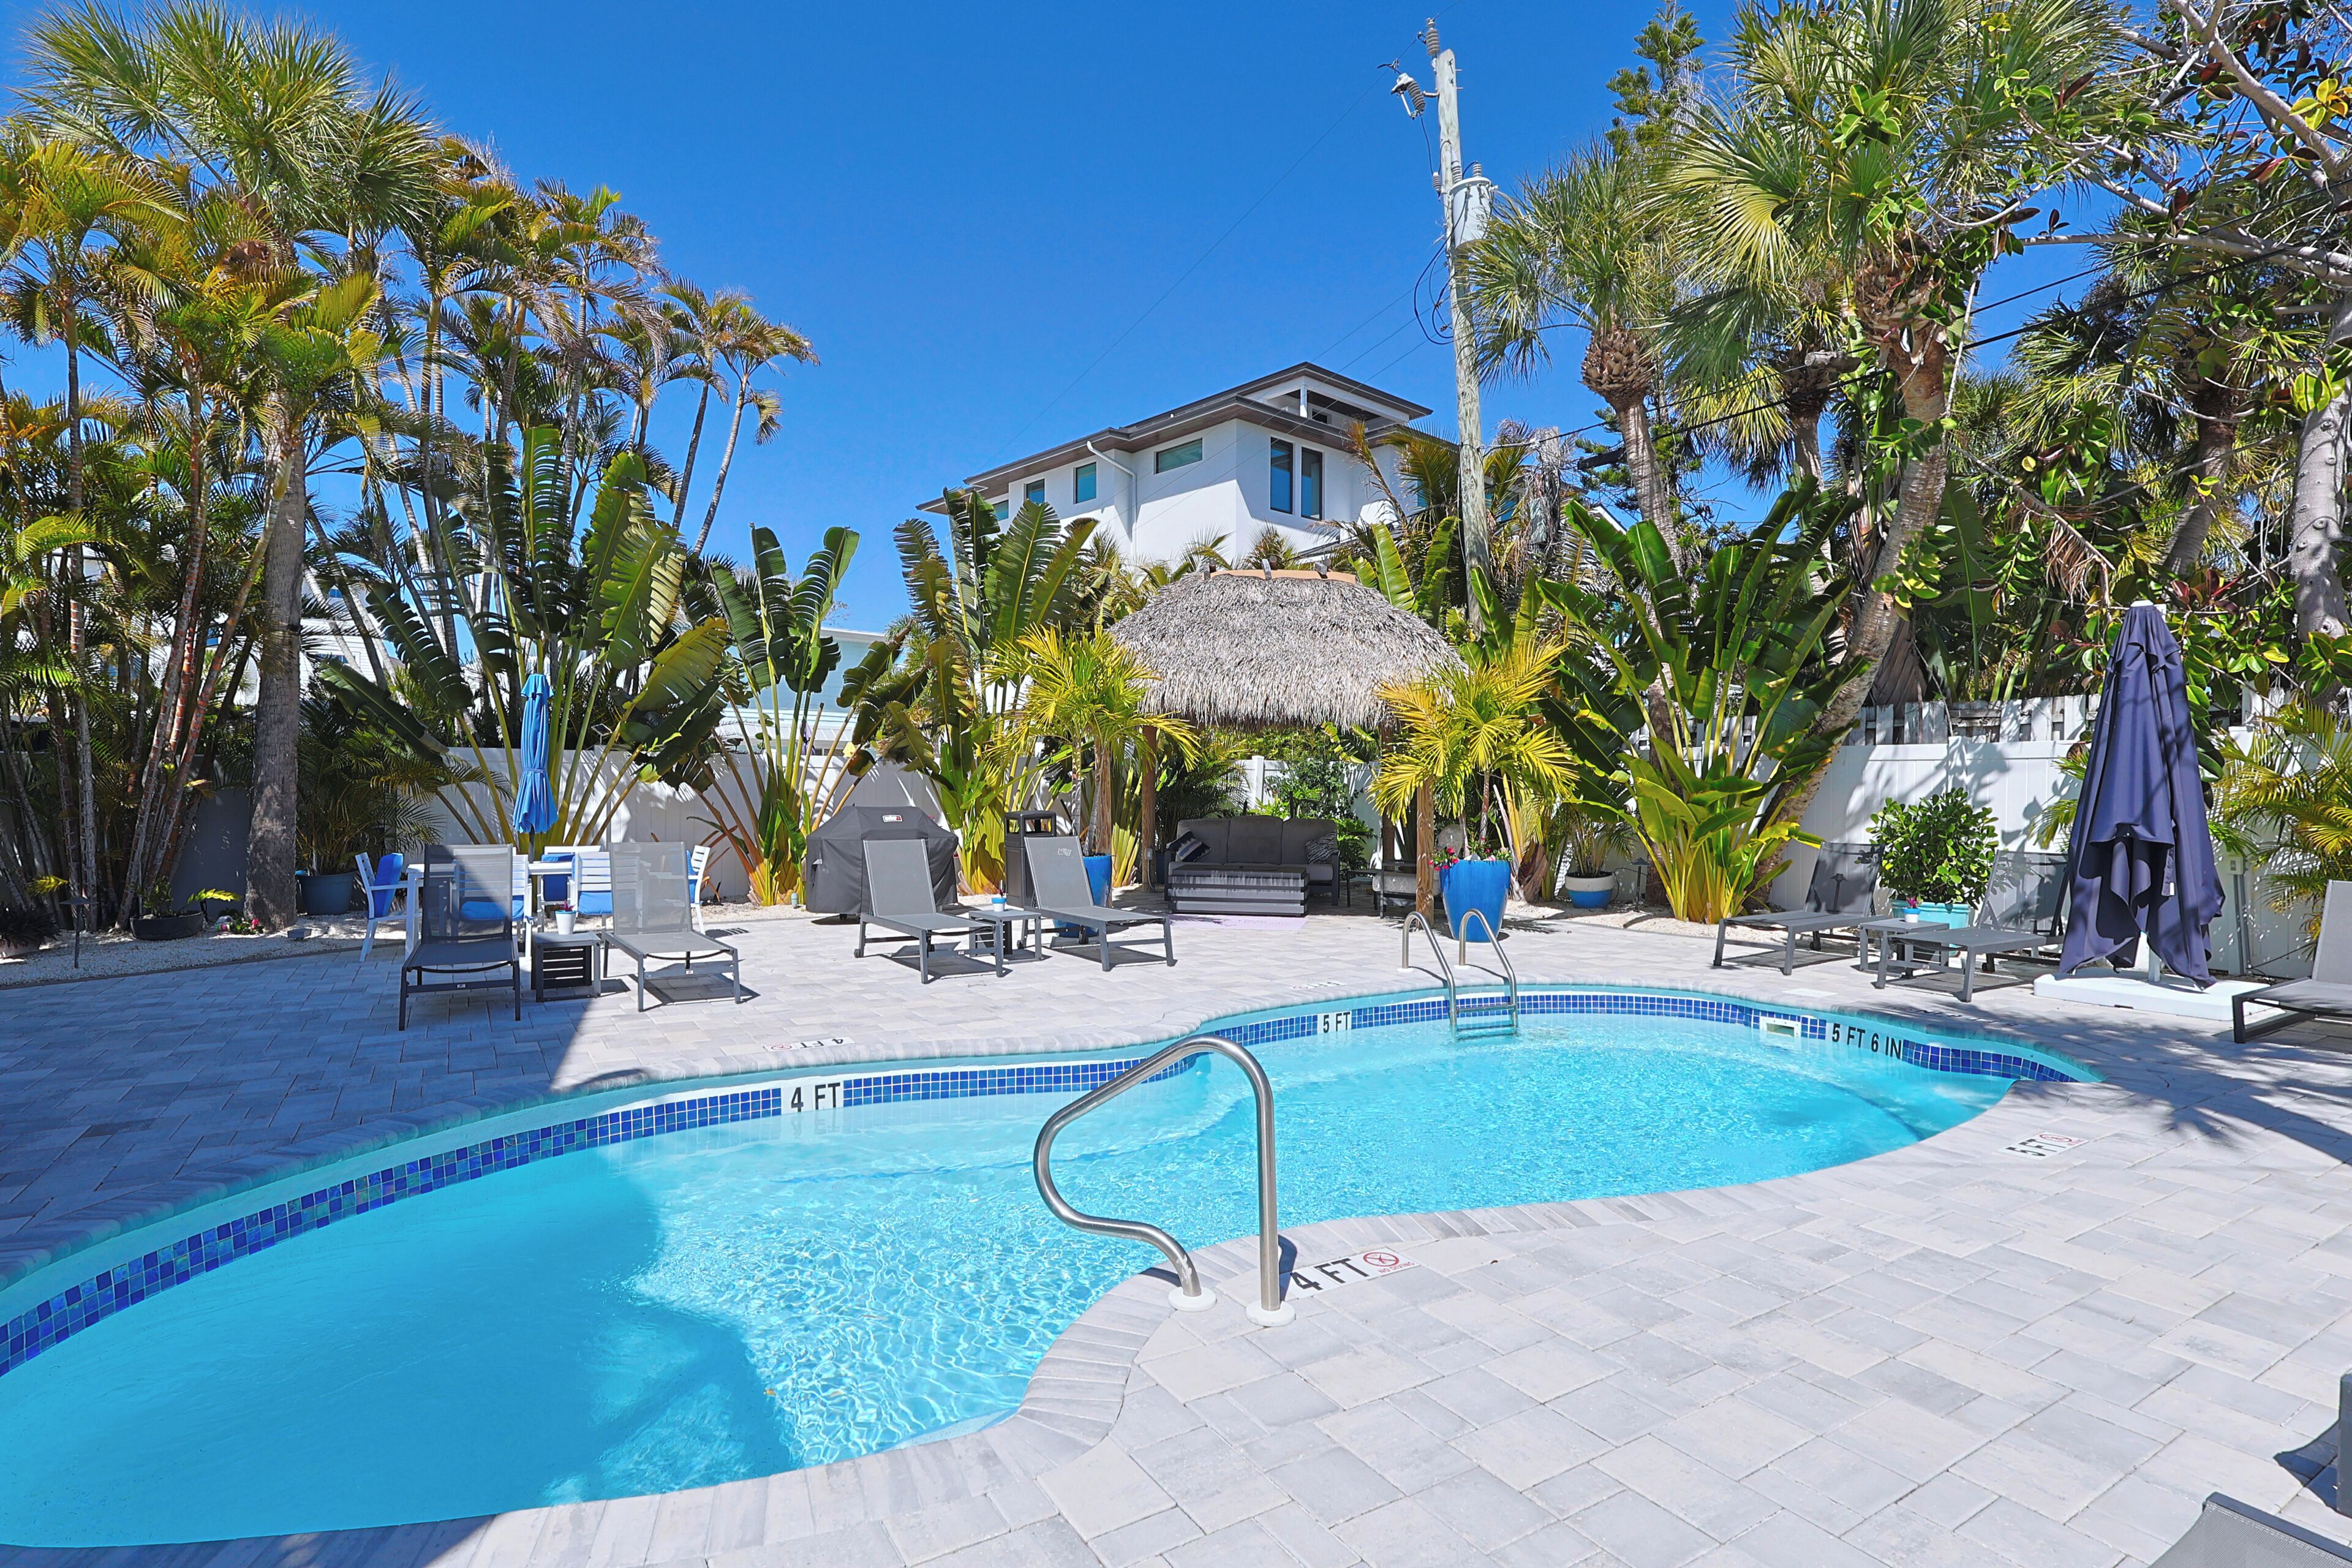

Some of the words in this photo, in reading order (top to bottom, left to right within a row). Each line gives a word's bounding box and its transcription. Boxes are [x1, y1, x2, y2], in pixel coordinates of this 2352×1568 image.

[1323, 1014, 1330, 1033] 5
[1336, 1012, 1351, 1031] FT
[800, 1041, 825, 1049] FT
[1832, 1023, 1841, 1042] 5
[1847, 1027, 1866, 1048] FT
[1871, 1033, 1879, 1052] 6
[1885, 1036, 1902, 1059] IN
[791, 1087, 804, 1112] 4
[815, 1082, 840, 1110] FT
[2005, 1147, 2046, 1156] 5
[2018, 1138, 2067, 1152] FT
[1389, 1261, 1415, 1270] DIVING
[1290, 1272, 1323, 1291] 4
[1313, 1258, 1370, 1284] FT
